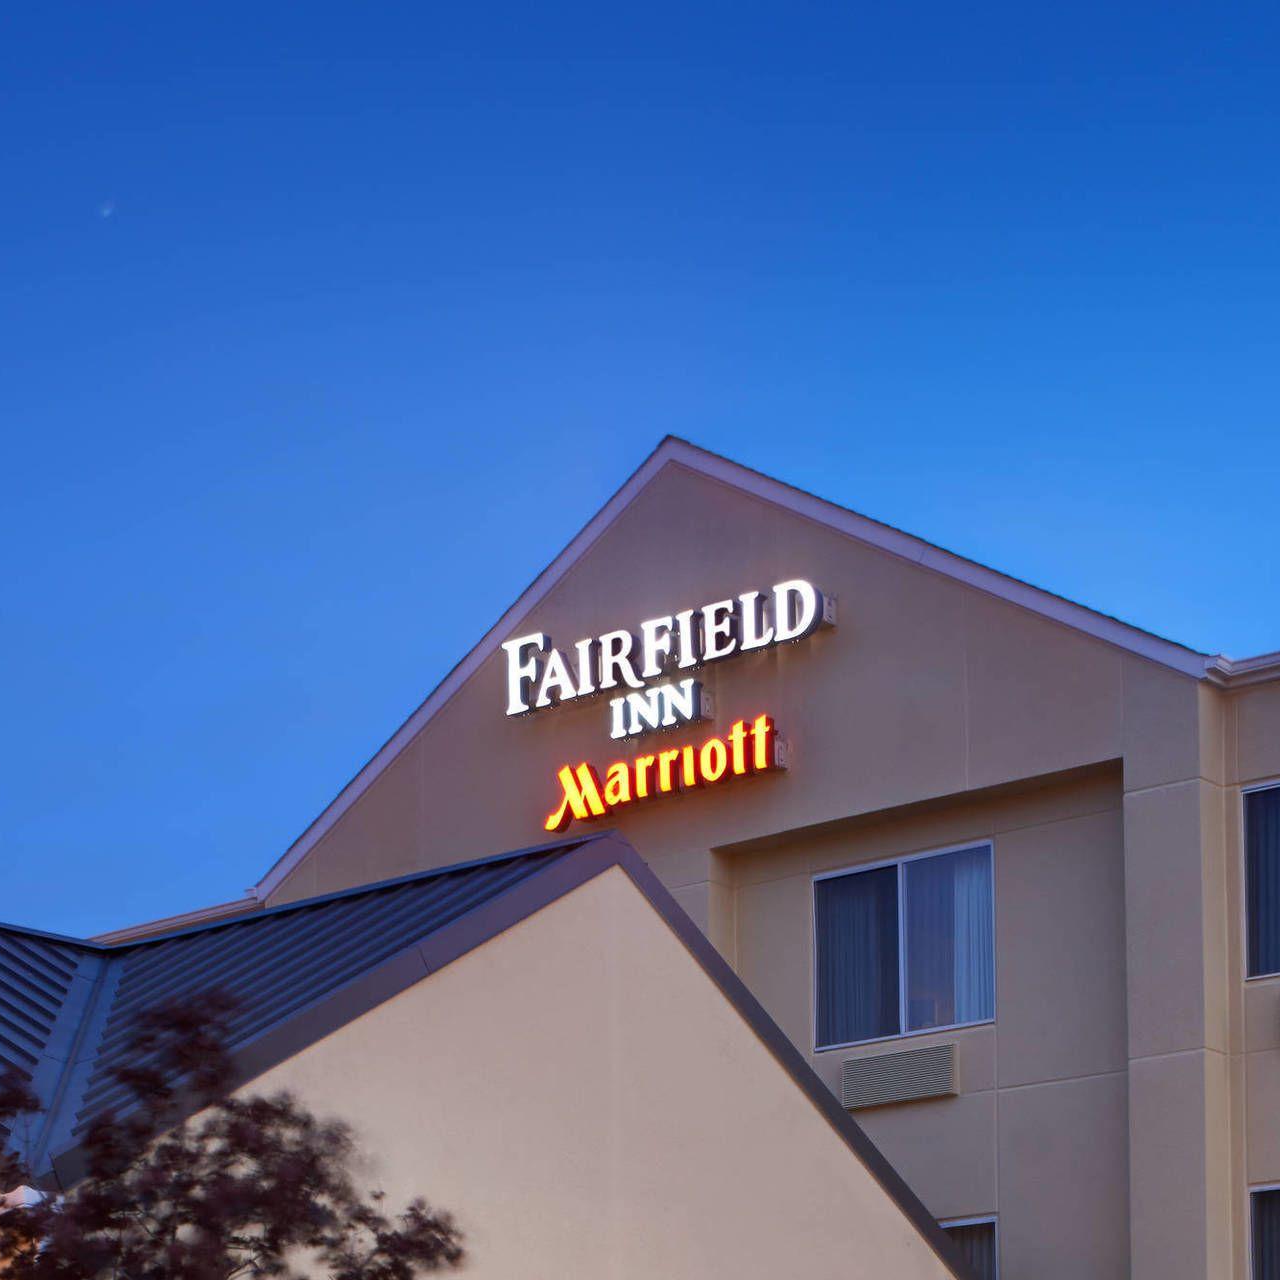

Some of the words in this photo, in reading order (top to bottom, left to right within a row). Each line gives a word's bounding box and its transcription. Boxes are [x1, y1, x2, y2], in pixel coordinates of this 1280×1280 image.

[501, 579, 818, 716] FAIRFIELD
[609, 678, 695, 740] INN
[543, 713, 772, 832] Marriott
